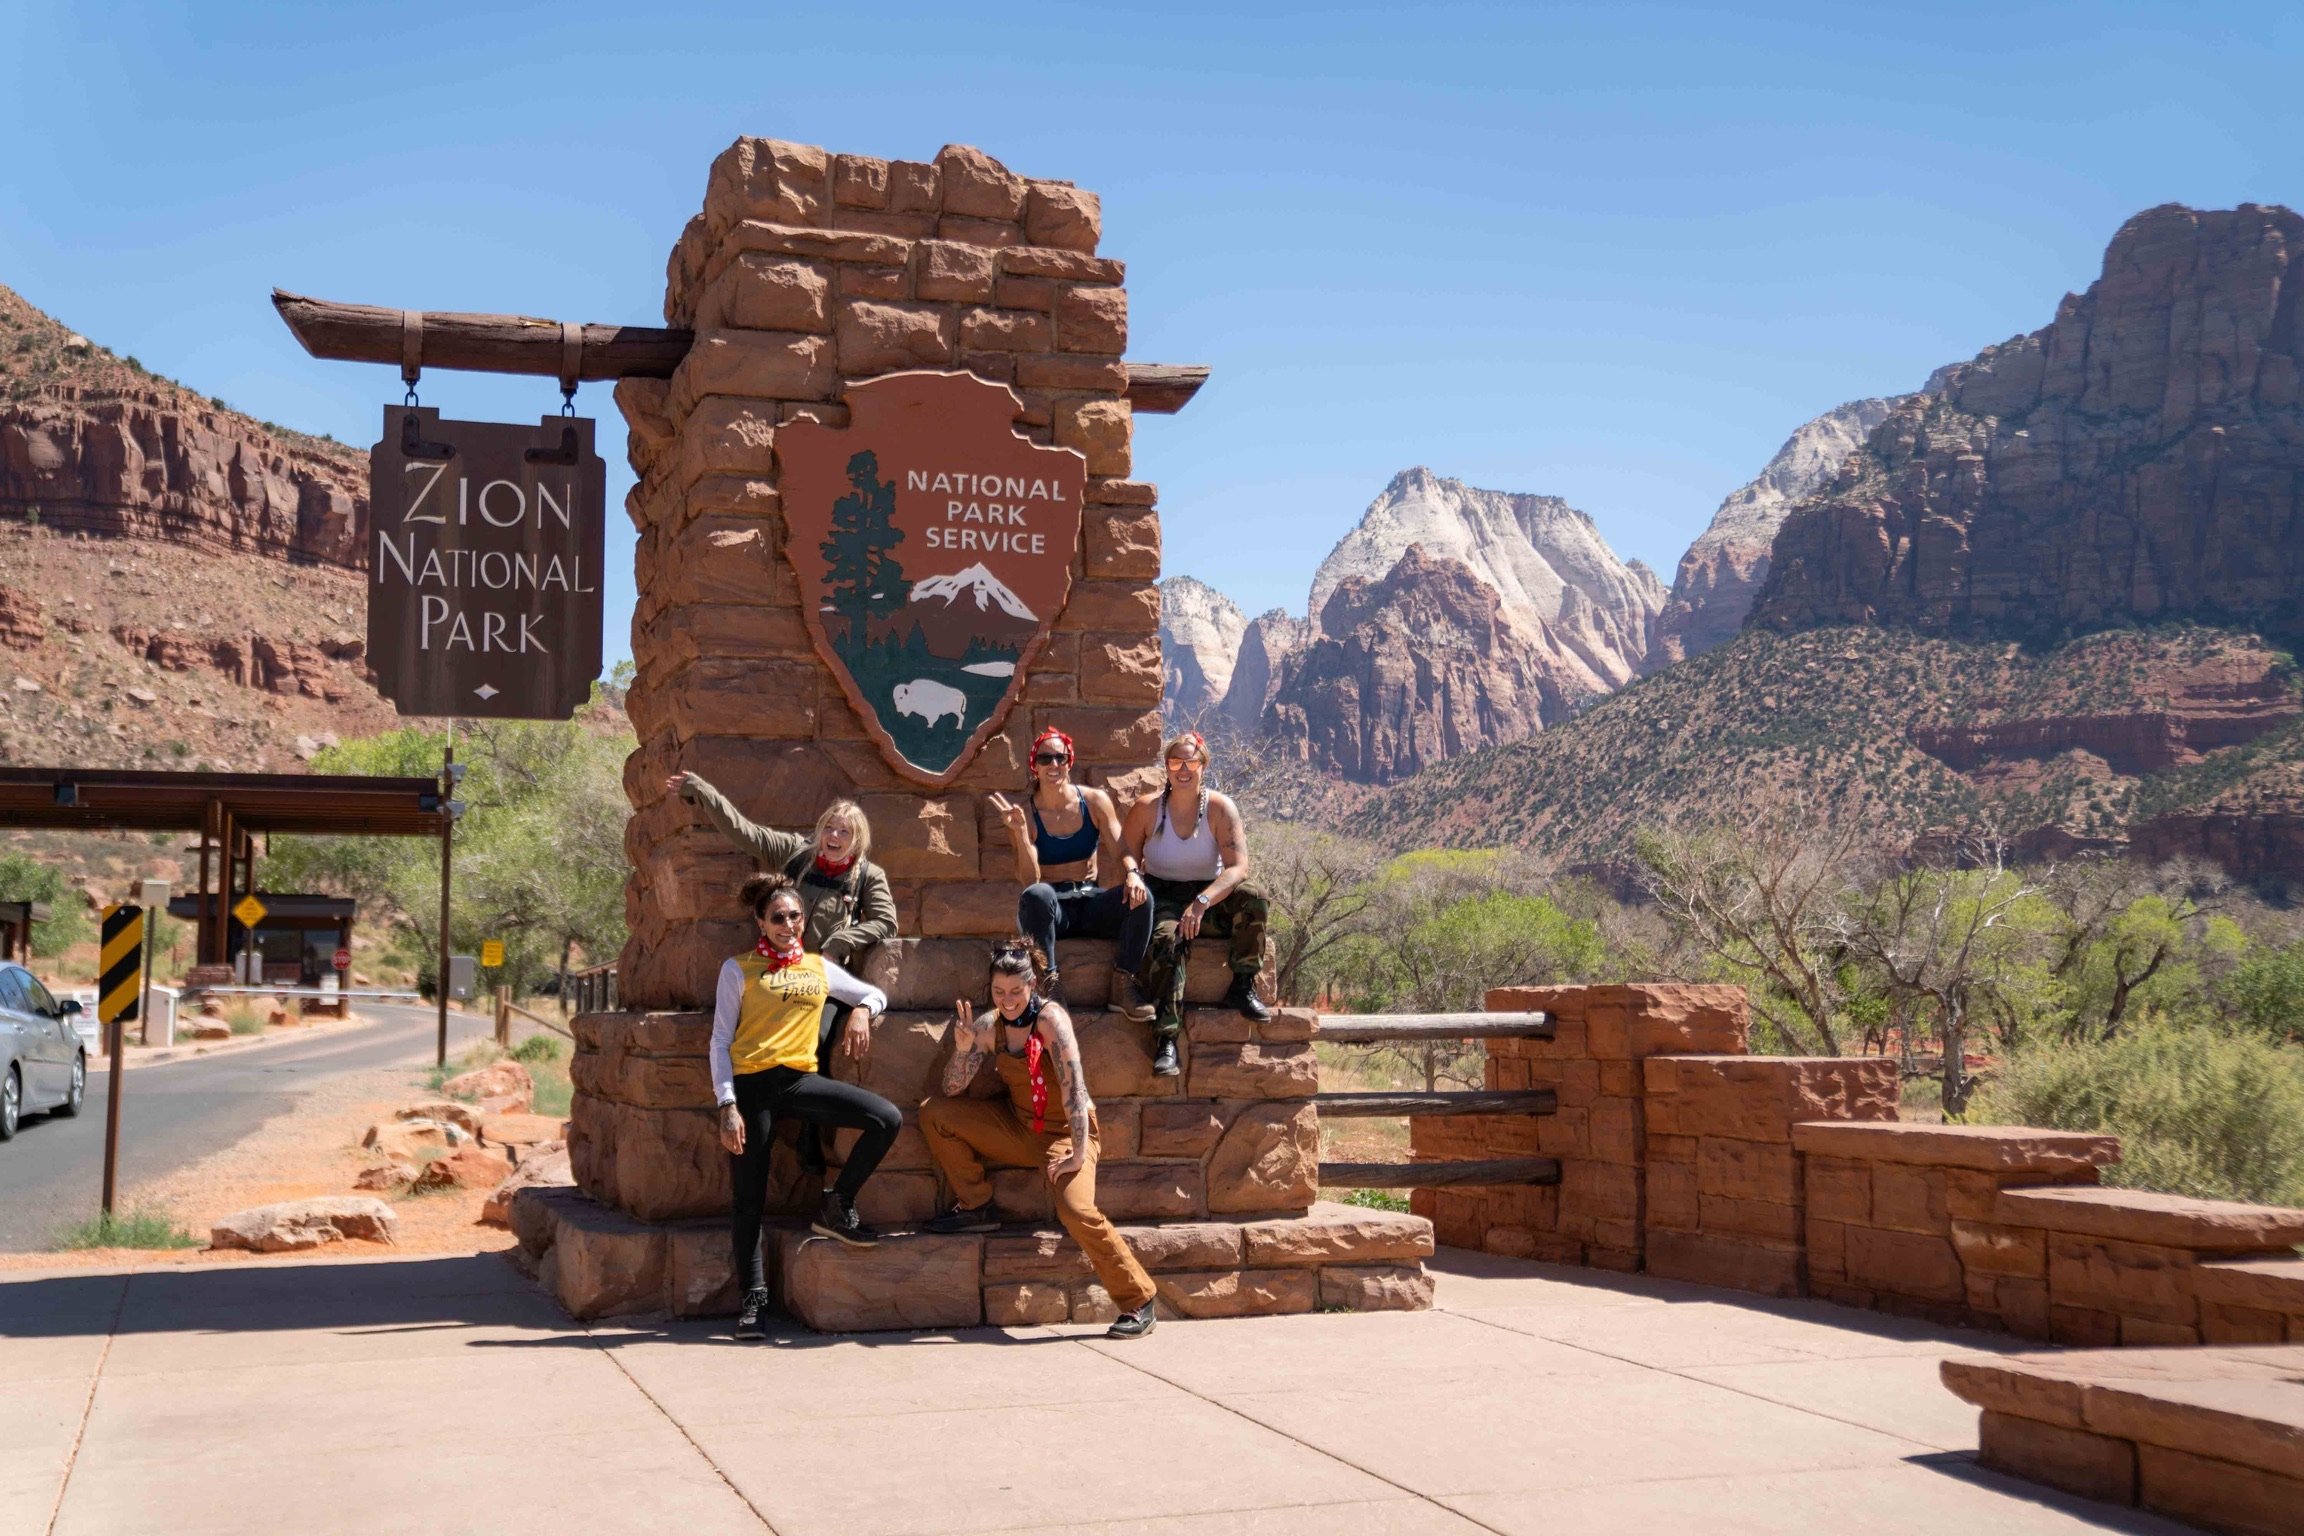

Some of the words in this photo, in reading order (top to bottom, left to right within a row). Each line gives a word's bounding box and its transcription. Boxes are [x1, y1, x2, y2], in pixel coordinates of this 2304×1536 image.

[403, 463, 571, 530] ZION
[908, 470, 1066, 501] NATIONAL
[947, 501, 1027, 526] PARK
[378, 530, 594, 593] NATIONAL
[926, 527, 1045, 554] SERVICE
[421, 595, 549, 654] PARK
